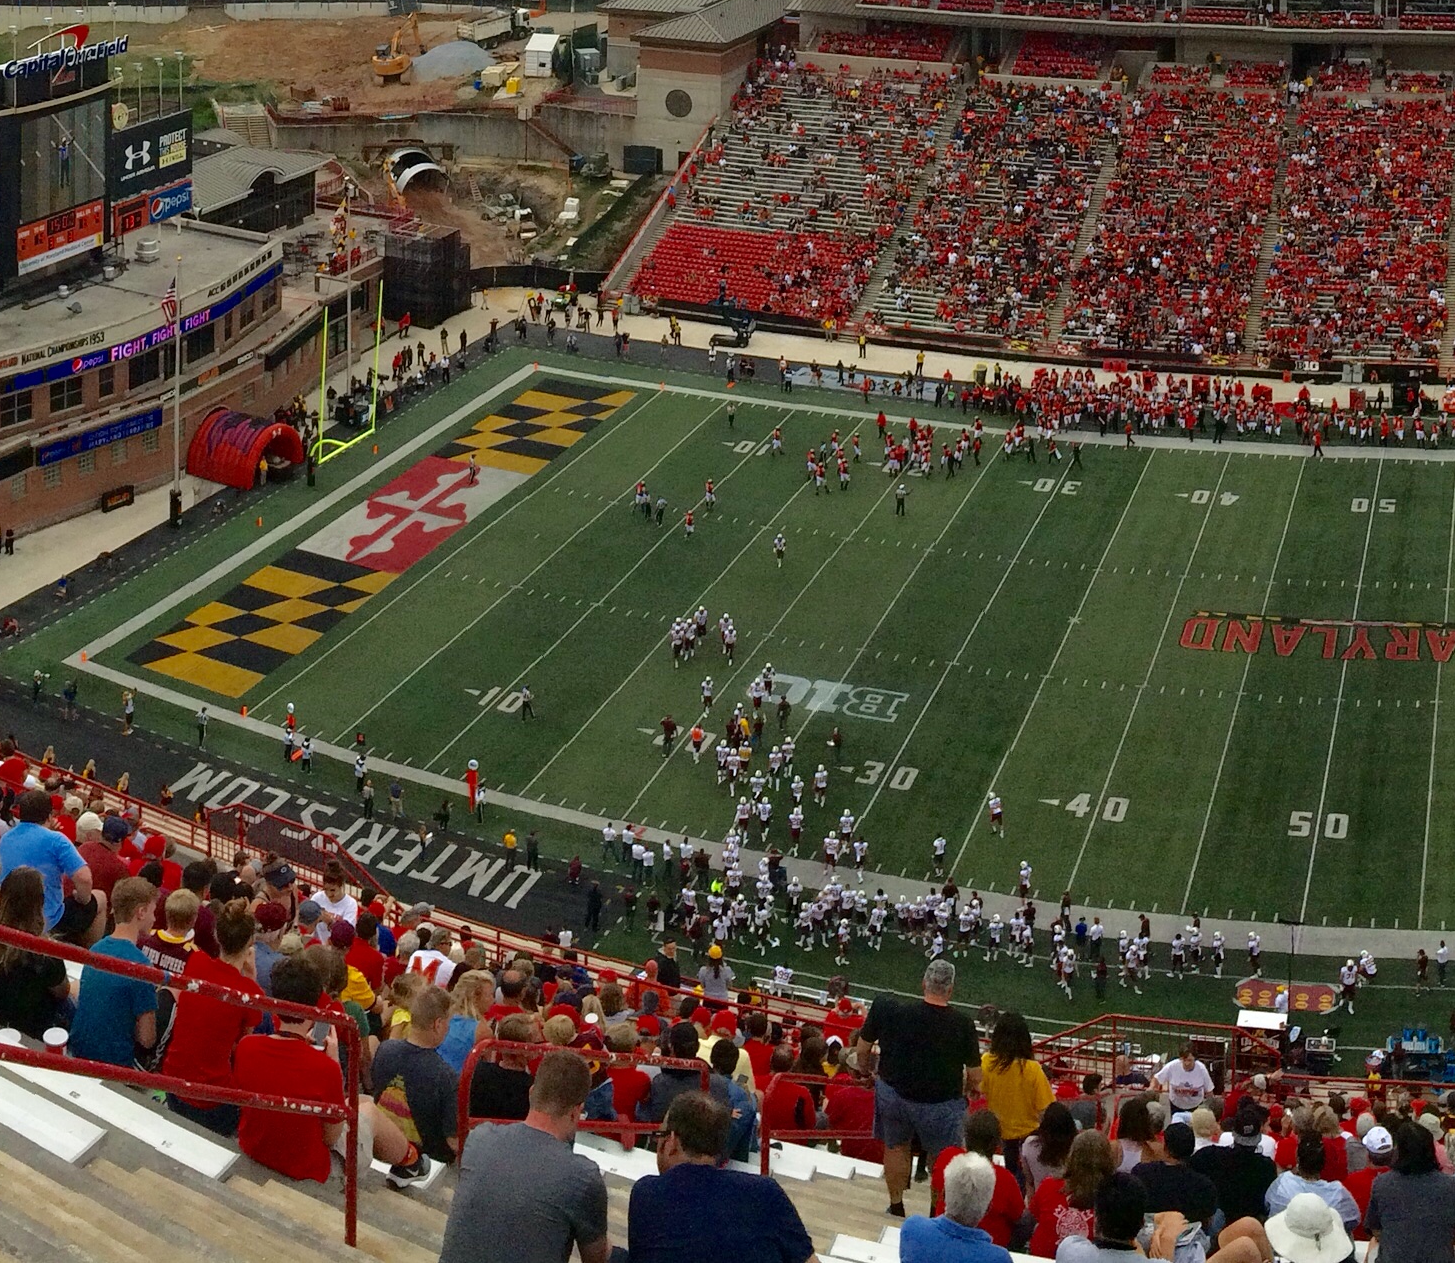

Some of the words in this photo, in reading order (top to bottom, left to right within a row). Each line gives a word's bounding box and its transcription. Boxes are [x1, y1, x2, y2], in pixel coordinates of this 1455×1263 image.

[4, 49, 64, 79] Capital
[159, 128, 188, 148] PROTECT
[163, 191, 191, 214] pepsi
[125, 216, 135, 228] 13
[208, 286, 220, 298] ACC
[89, 331, 106, 345] 1953
[111, 336, 149, 362] FIGHT,
[184, 309, 211, 330] FIGHT
[82, 353, 104, 369] pepsi
[1030, 477, 1084, 498] 30
[1189, 489, 1240, 507] 40
[1350, 497, 1397, 515] 50
[477, 685, 525, 714] 10
[855, 759, 919, 792] 30
[1065, 792, 1131, 824] 40
[168, 761, 546, 910] UMTERPS.COM
[1288, 811, 1350, 841] 50
[410, 955, 443, 985] M
